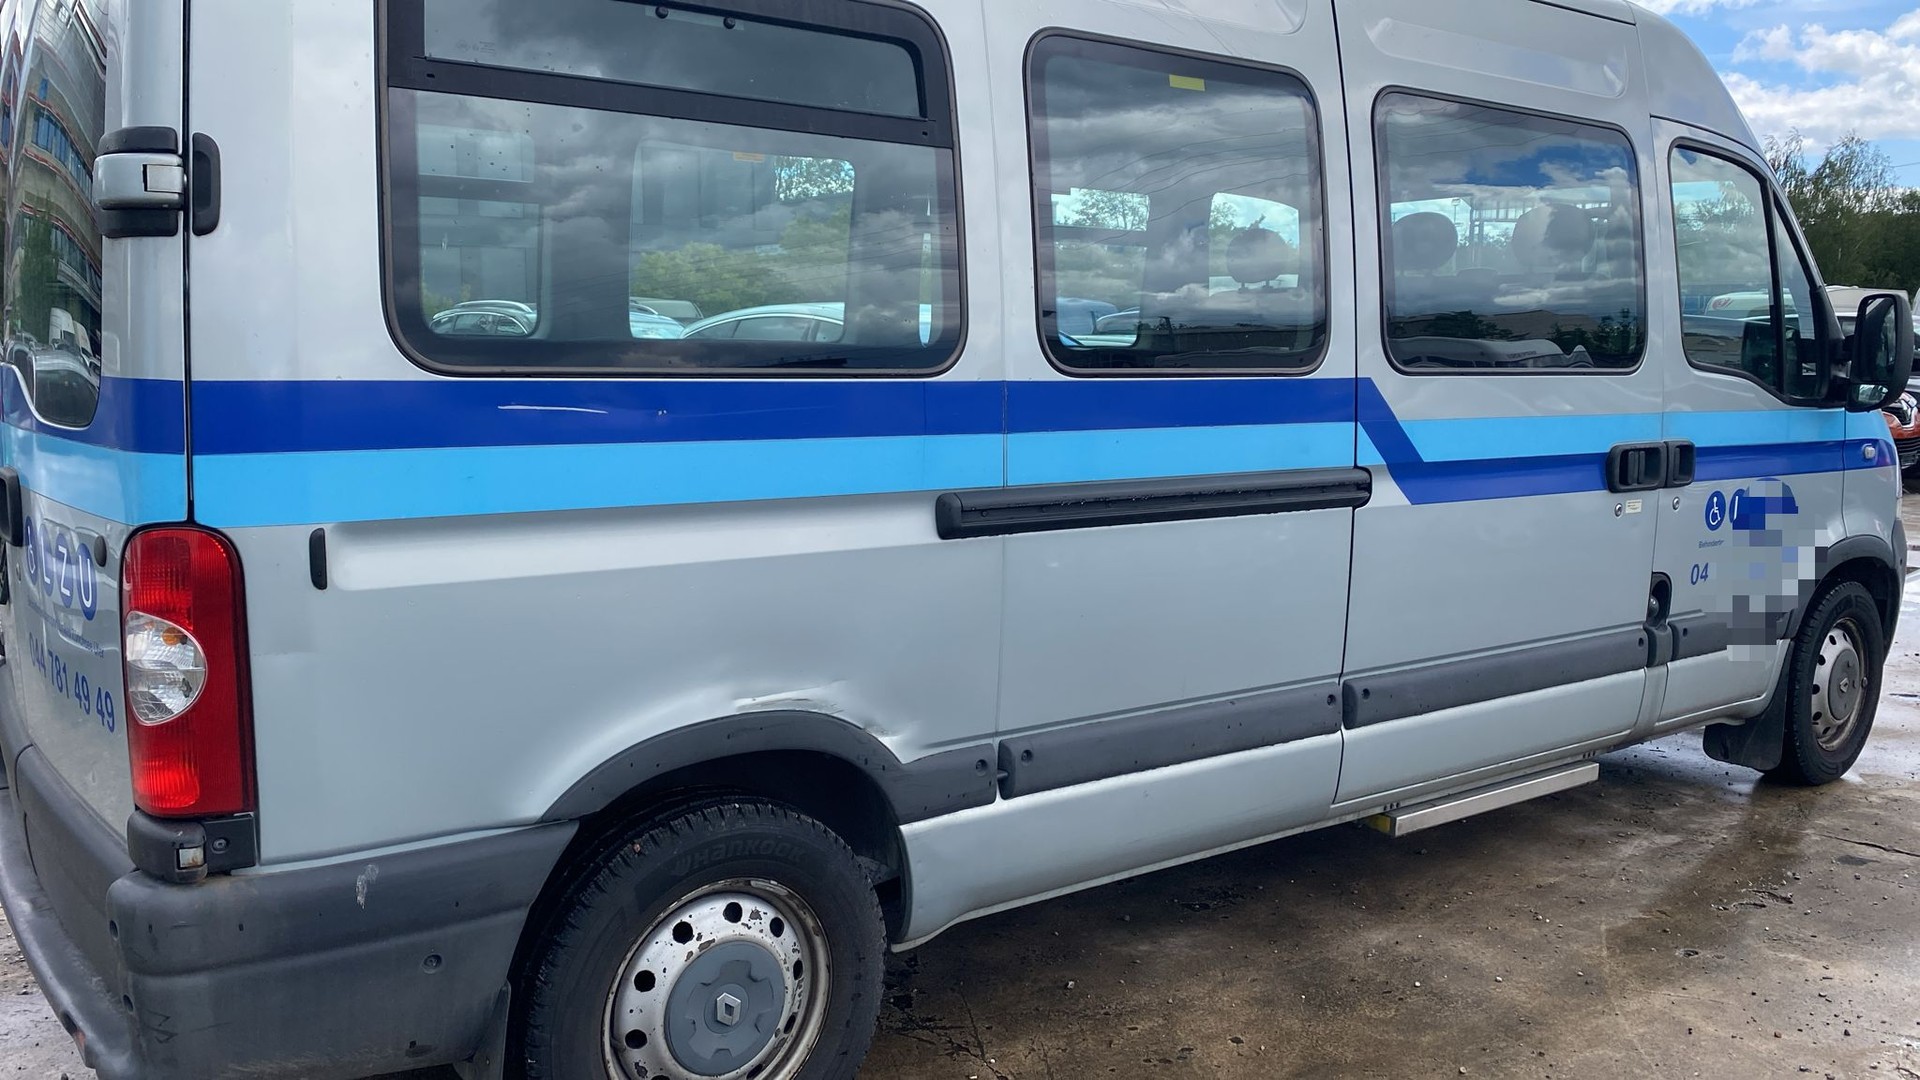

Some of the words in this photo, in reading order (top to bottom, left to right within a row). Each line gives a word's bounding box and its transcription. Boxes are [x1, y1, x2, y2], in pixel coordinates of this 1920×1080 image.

[29, 631, 47, 680] 044
[47, 648, 70, 700] 781
[74, 671, 91, 715] 49
[96, 686, 115, 733] 49
